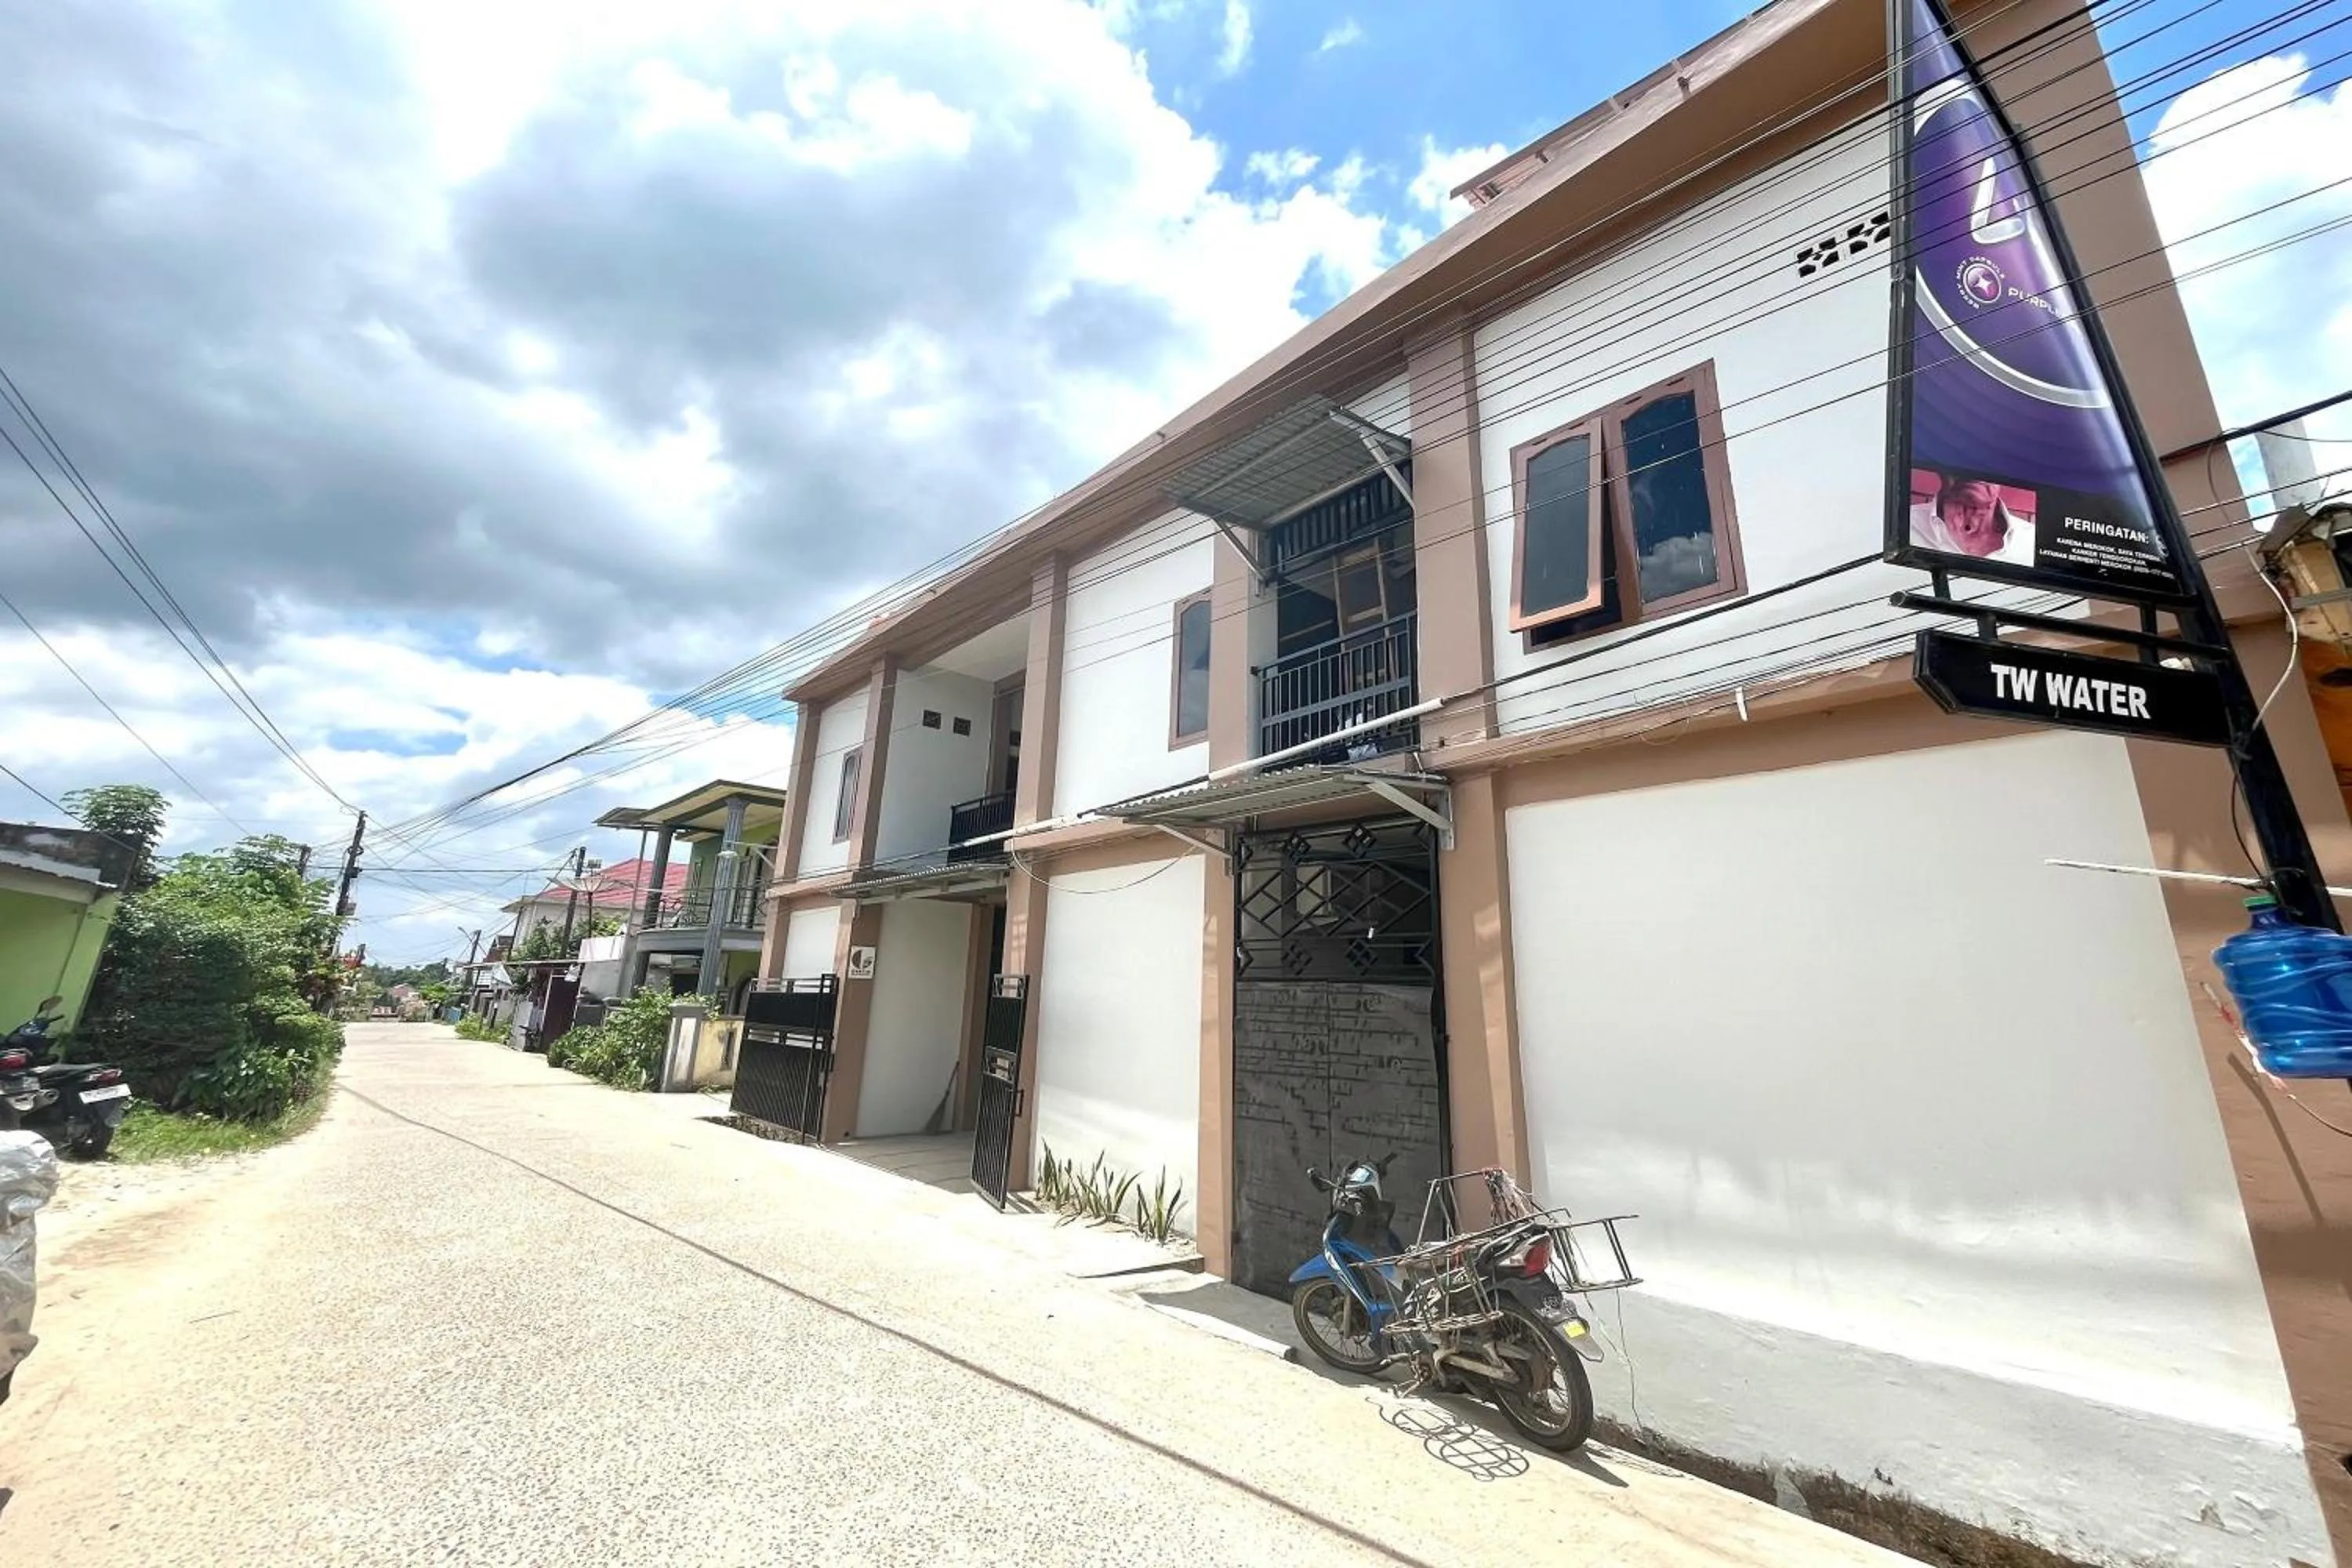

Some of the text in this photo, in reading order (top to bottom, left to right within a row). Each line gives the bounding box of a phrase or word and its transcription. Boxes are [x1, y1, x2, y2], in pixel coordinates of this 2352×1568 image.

[2064, 517, 2150, 544] PERINGATAN:
[1991, 663, 2151, 719] TW WATER
